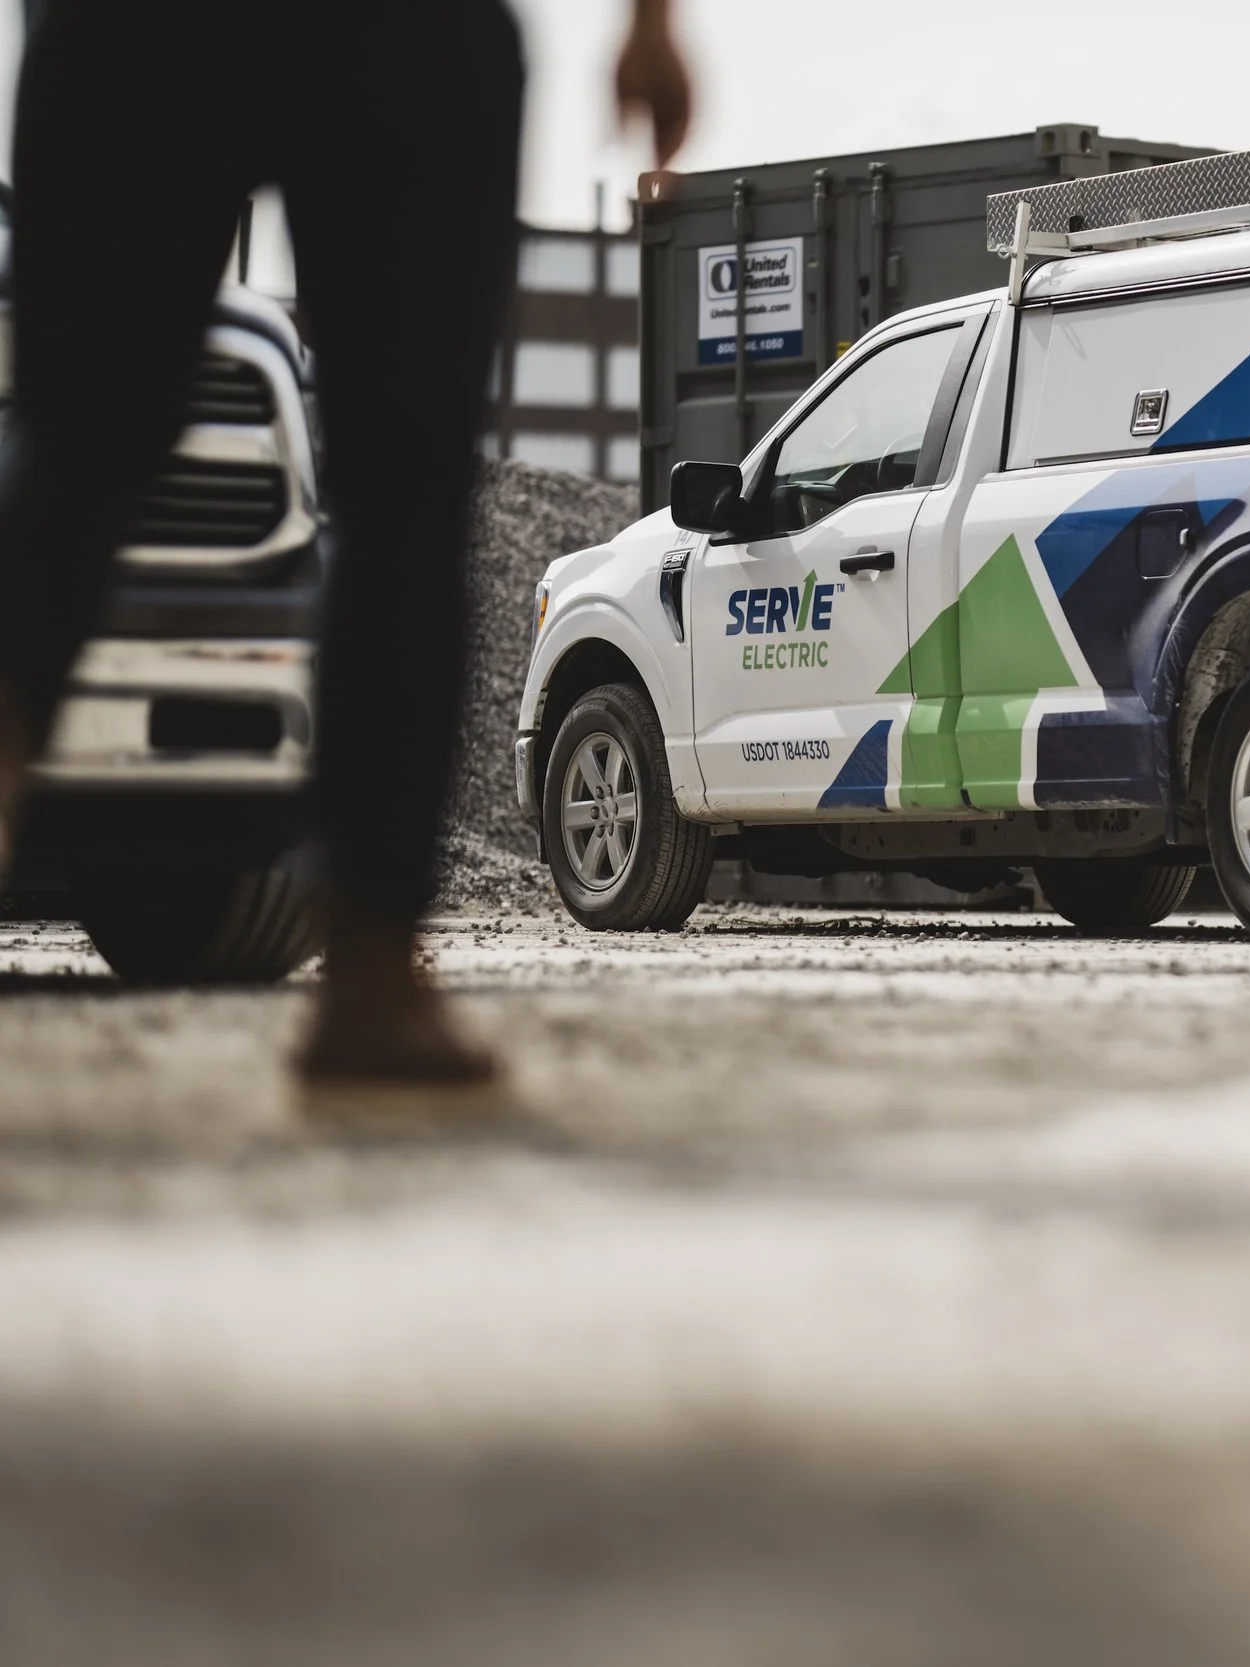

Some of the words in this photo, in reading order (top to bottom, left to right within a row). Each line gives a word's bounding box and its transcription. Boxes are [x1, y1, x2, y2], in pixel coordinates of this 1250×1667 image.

[744, 254, 788, 272] United
[744, 272, 791, 289] Rentals
[726, 570, 834, 635] SERVE
[742, 641, 828, 670] ELECTRIC
[742, 743, 779, 761] USDOT
[782, 740, 830, 760] 1844330
